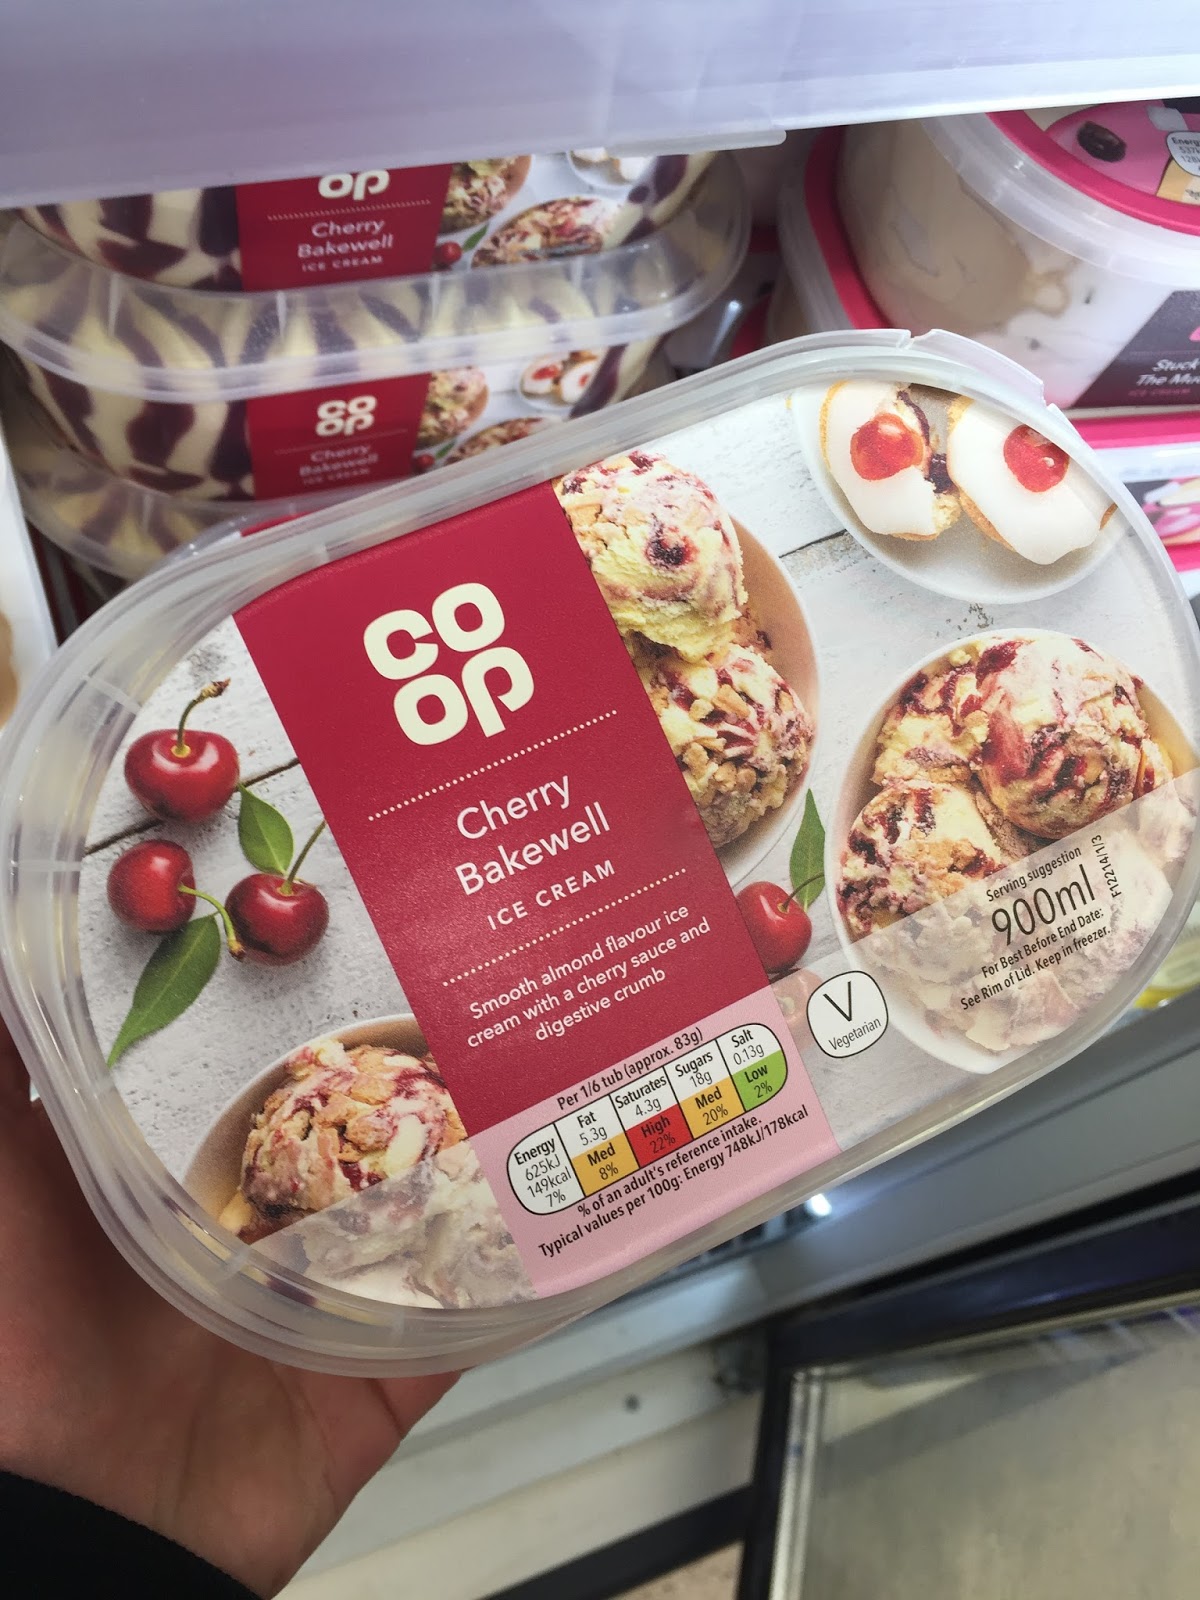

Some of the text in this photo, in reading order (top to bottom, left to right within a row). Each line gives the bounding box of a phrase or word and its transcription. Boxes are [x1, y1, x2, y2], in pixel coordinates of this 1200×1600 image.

[311, 219, 385, 238] Cherry
[298, 233, 393, 258] Bakewell
[302, 255, 384, 272] ICE CREAM
[1136, 373, 1168, 386] The
[299, 453, 379, 477] Bakewell
[310, 445, 371, 463] Cherry
[456, 774, 571, 839] Cherry
[454, 801, 610, 896] Bakewell
[986, 847, 1082, 902] Serving suggestion
[1091, 835, 1122, 898] F12214/1/3
[487, 860, 616, 931] ICE CREAM
[992, 864, 1095, 946] 900ml
[981, 908, 1104, 979] For Best Before End Date:
[469, 905, 690, 1019] Smooth almond flavour ice
[960, 924, 1111, 1011] See Rim of Lid. Keep in freezer.
[467, 916, 711, 1048] cream with a cherry sauce and
[535, 967, 666, 1042] digestive crumb
[823, 980, 852, 1022] V
[731, 1028, 754, 1049] Salt
[828, 1017, 882, 1051] Vegetarian
[675, 1052, 713, 1078] Sugars
[733, 1044, 765, 1066] 0.13g
[557, 1026, 703, 1110] Per 1/6 tub (approx. 83g)
[690, 1071, 713, 1088] 18g
[744, 1065, 768, 1083] Low
[615, 1076, 667, 1109] Saturates
[694, 1089, 723, 1109] Med
[754, 1082, 773, 1099] 2%
[635, 1097, 662, 1117] 4.3g
[702, 1105, 729, 1126] 20%
[577, 1111, 597, 1129] Fat
[640, 1116, 671, 1138] High
[580, 1125, 608, 1146] 5.3g
[650, 1133, 677, 1154] 22%
[514, 1138, 557, 1166] Energy
[587, 1144, 616, 1166] Med
[525, 1155, 561, 1181] 625kJ
[578, 1117, 762, 1218] % of an adult's reference intake.
[599, 1162, 619, 1181] 8%
[527, 1167, 572, 1198] 149kcal
[538, 1106, 809, 1258] Typical values per 100g: Energy 748kJ/178kcal
[546, 1191, 566, 1208] 7%
